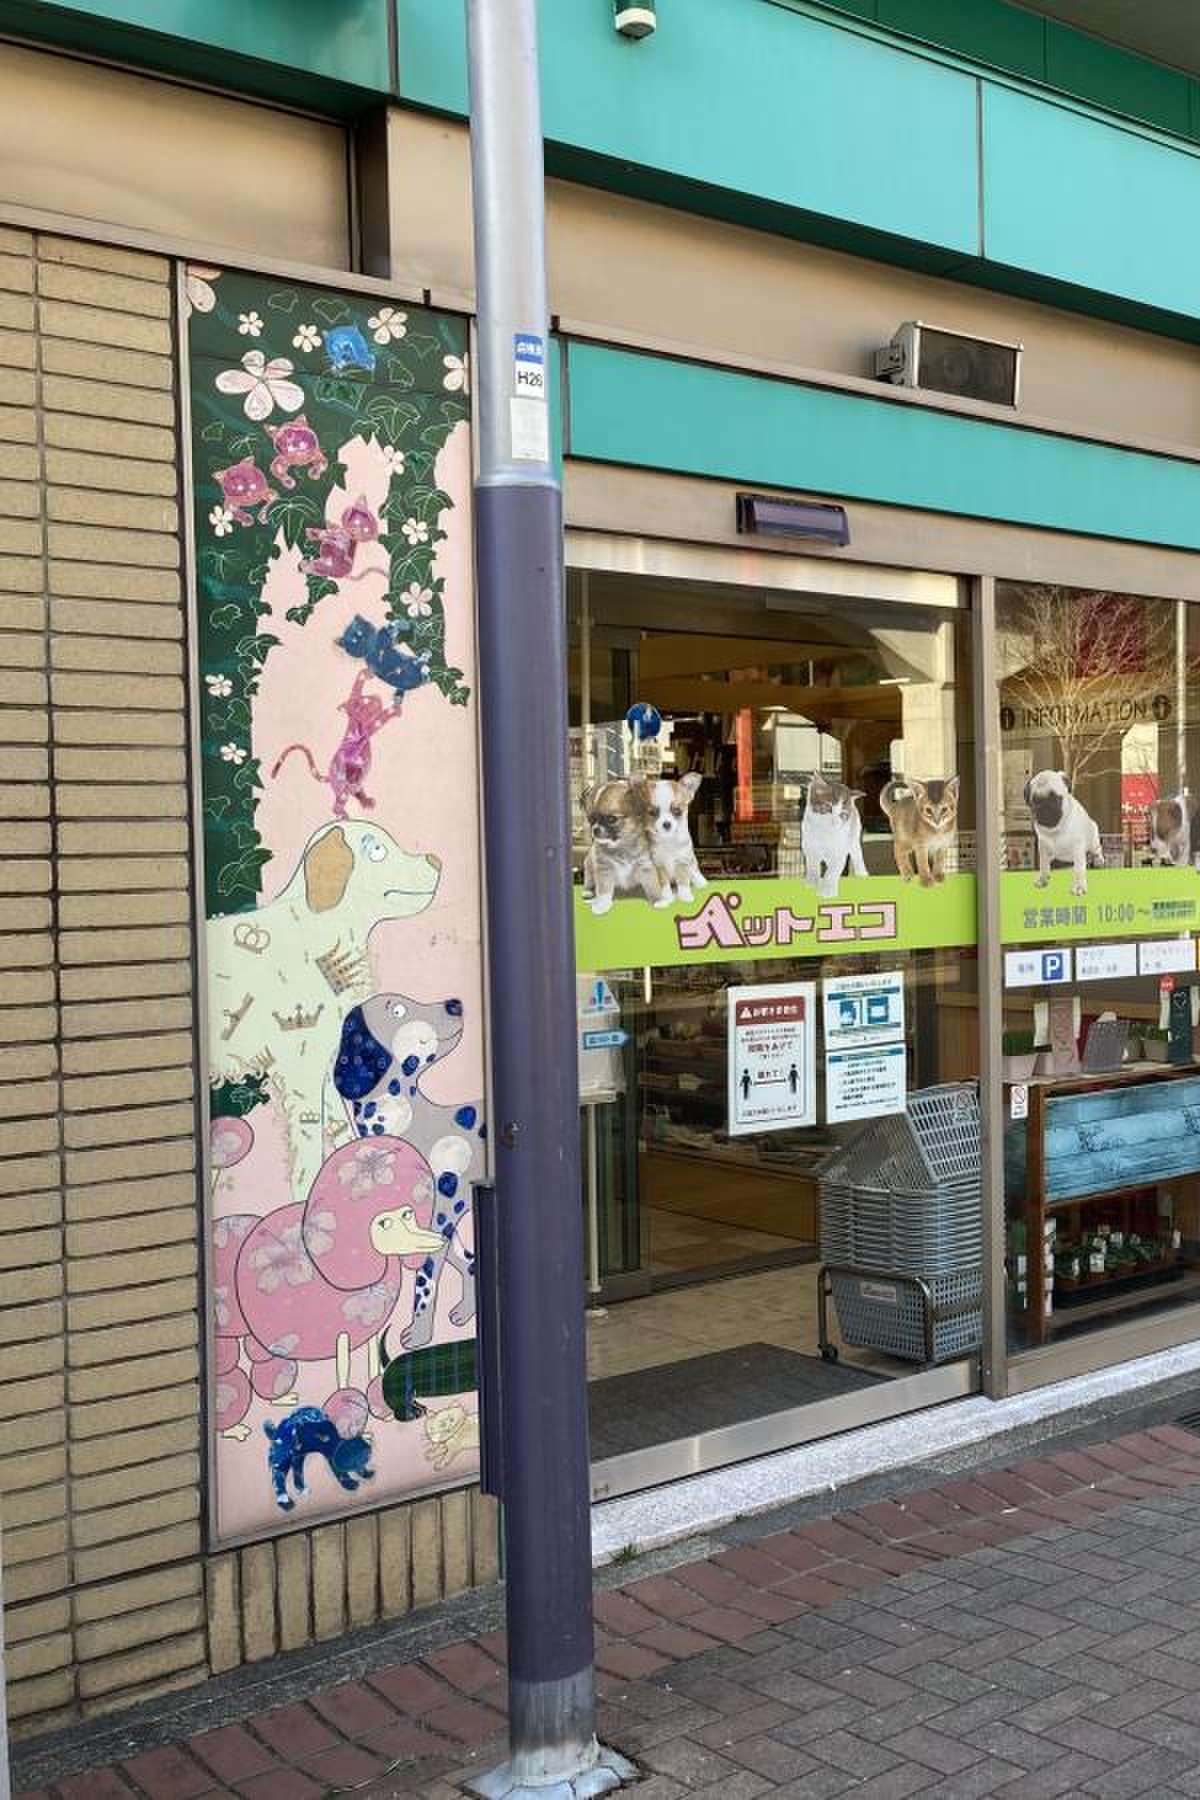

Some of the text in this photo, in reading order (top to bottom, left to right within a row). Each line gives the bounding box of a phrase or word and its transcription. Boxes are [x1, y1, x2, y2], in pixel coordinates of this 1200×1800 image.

[518, 370, 543, 387] H26
[1022, 698, 1148, 727] INFORMATION
[675, 891, 897, 950] ペットエコ
[1023, 905, 1087, 929] 営業時間
[1046, 955, 1060, 978] P
